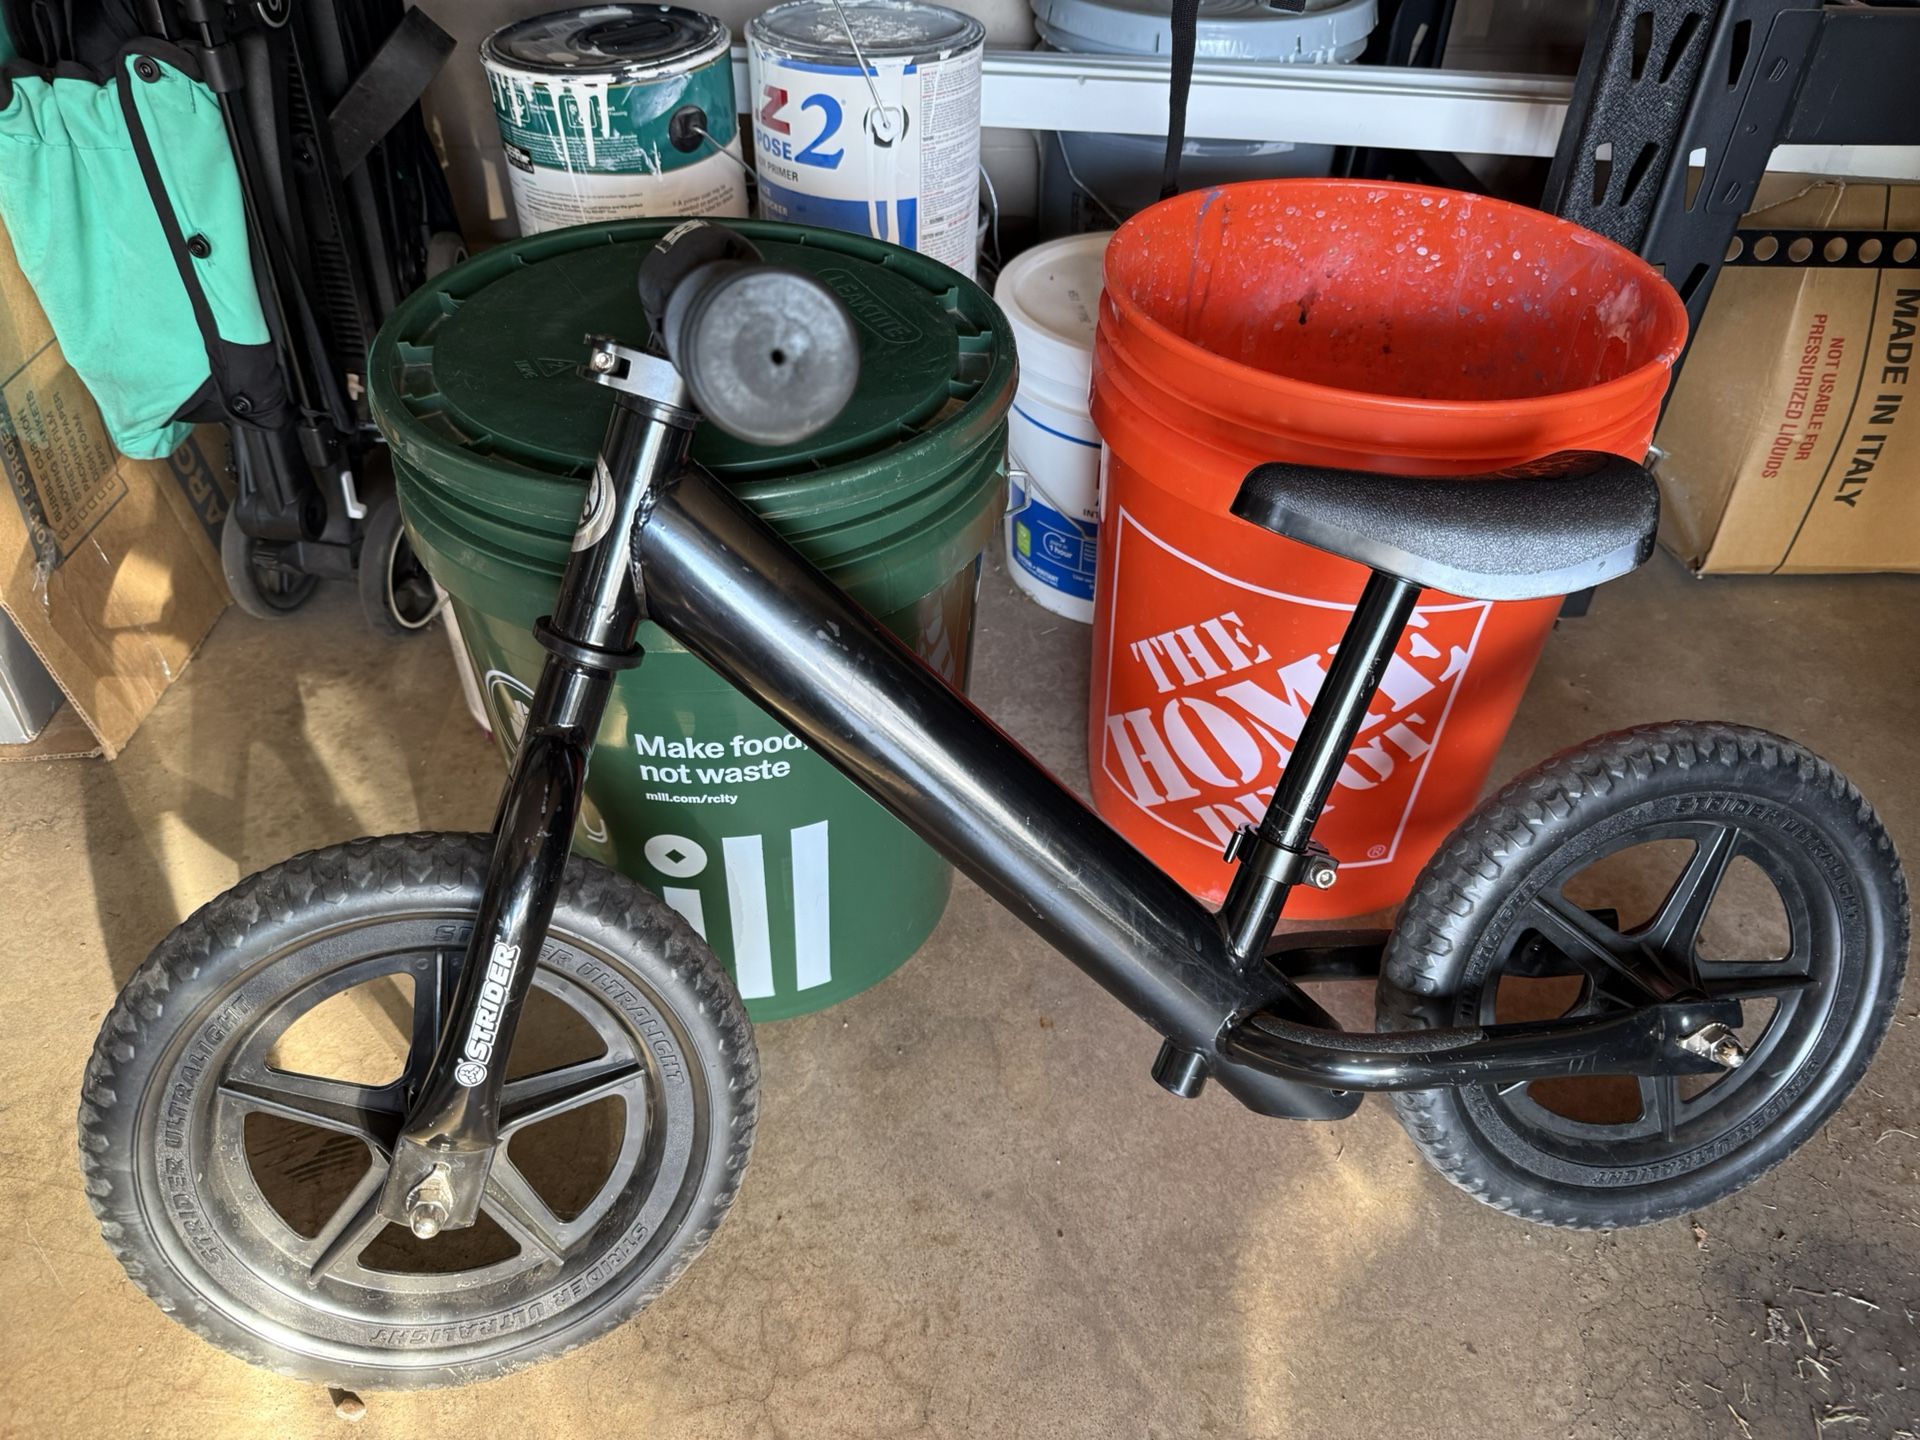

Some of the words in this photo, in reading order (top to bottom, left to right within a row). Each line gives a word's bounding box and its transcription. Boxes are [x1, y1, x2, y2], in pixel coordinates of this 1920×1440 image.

[799, 93, 844, 169] 2
[1827, 337, 1846, 369] NOT
[1881, 289, 1920, 384] MADE
[1785, 313, 1828, 420] PRESSURIZED
[26, 390, 54, 461] BLANKETS
[46, 410, 63, 444] FILM
[53, 391, 72, 437] PAPER
[1808, 372, 1838, 430] USABLE
[1868, 394, 1904, 425] IN
[17, 408, 45, 470] CUSHION
[73, 411, 90, 451] FOAM
[94, 440, 109, 475] TAPE
[1762, 423, 1797, 479] LIQUIDS
[1794, 433, 1818, 461] FOR
[50, 463, 73, 513] MOVING
[58, 444, 82, 503] STRETCH
[68, 438, 91, 493] PACKING
[84, 450, 100, 483] DISH
[1834, 435, 1887, 508] ITALY
[40, 474, 62, 523] BUBBLE
[1130, 611, 1272, 693] THE
[635, 733, 725, 759] Make
[640, 764, 692, 784] not
[696, 760, 791, 784] waste
[464, 942, 522, 1066] STRIDER
[575, 960, 686, 1086] ULTRALIGHT
[164, 993, 251, 1150] ULTRALIGHT
[164, 1157, 226, 1265] STRIDER
[553, 1222, 649, 1305] STRIDER
[369, 1303, 547, 1346] ULTRALIGHT
